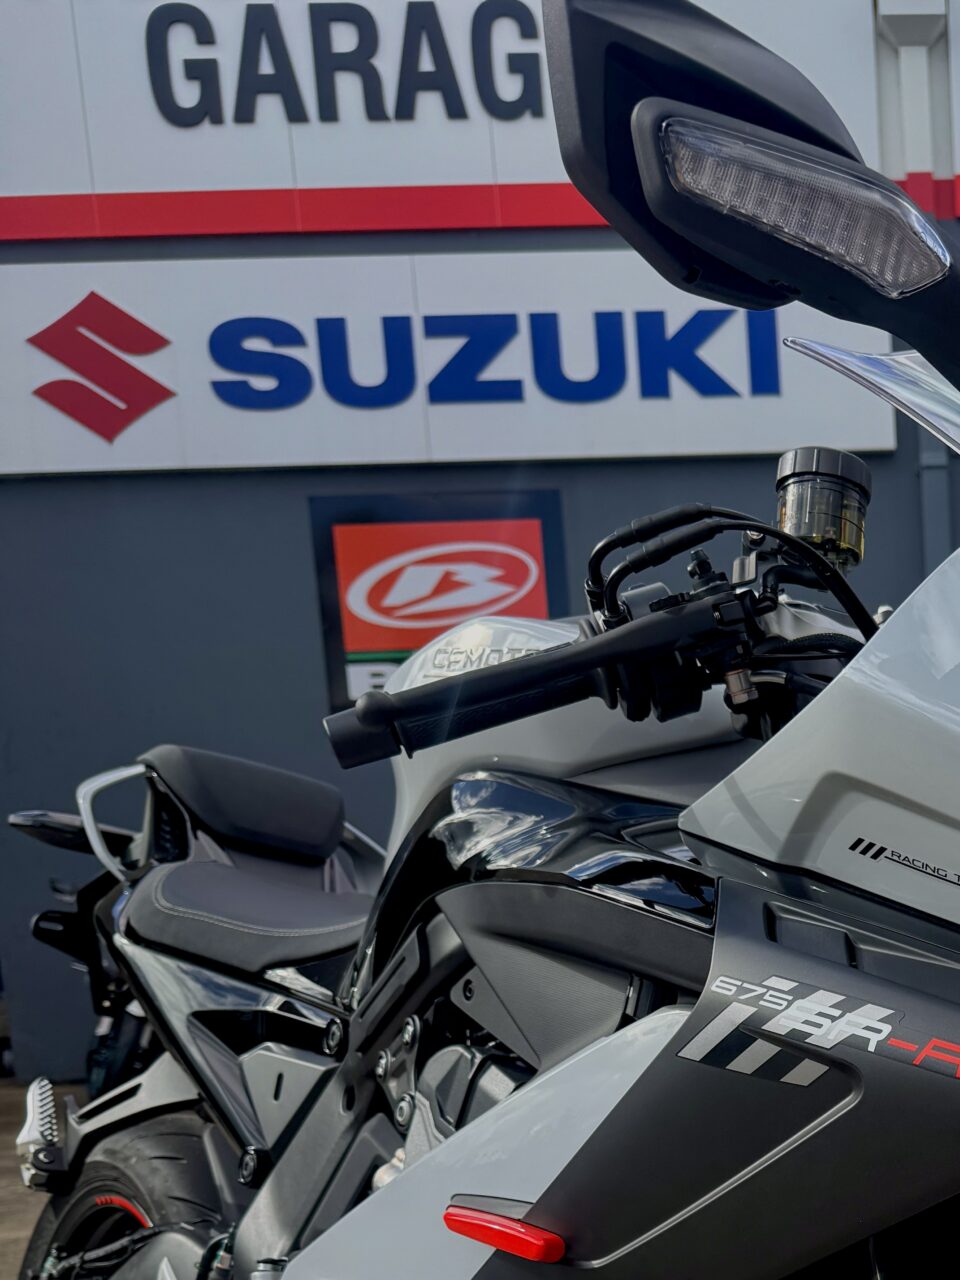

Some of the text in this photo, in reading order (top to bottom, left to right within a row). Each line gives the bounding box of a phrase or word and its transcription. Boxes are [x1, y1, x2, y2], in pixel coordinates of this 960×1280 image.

[146, 0, 545, 128] GARAG
[208, 309, 782, 410] SUZUKI
[432, 647, 543, 673] CFMOT
[890, 850, 949, 878] RACING
[710, 975, 794, 1011] 675
